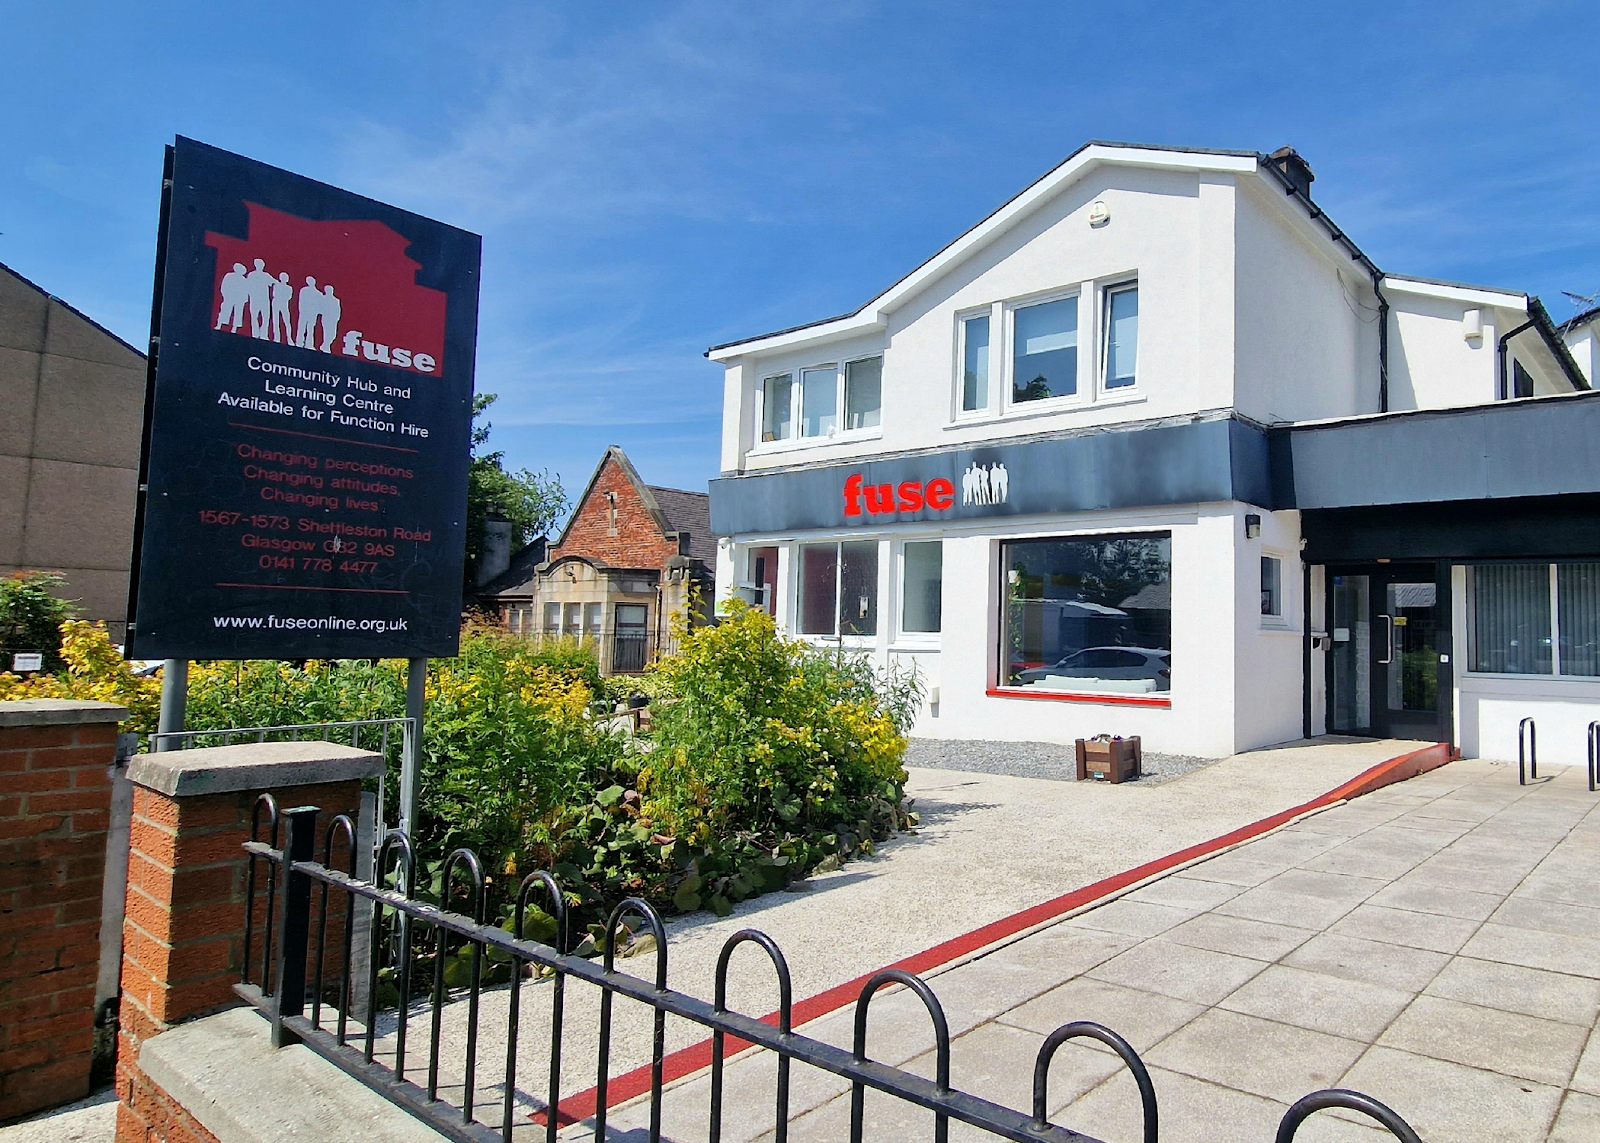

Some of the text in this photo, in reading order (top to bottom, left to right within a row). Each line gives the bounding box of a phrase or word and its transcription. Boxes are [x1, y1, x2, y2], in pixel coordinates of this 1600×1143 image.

[343, 331, 436, 373] fuse
[247, 356, 411, 400] Community Hub and
[265, 379, 394, 415] Learning Centre
[218, 391, 429, 438] Available for Function Hire
[244, 464, 324, 488] Changing
[260, 486, 338, 510] Changing
[844, 474, 956, 517] fuse
[199, 510, 432, 542] 1567-1573 Shettleston Road
[241, 533, 316, 554] Glasgow
[364, 542, 396, 557] 9AS
[259, 554, 378, 574] 0141 778 4477
[213, 614, 408, 632] www.fuseonline.org.uk
